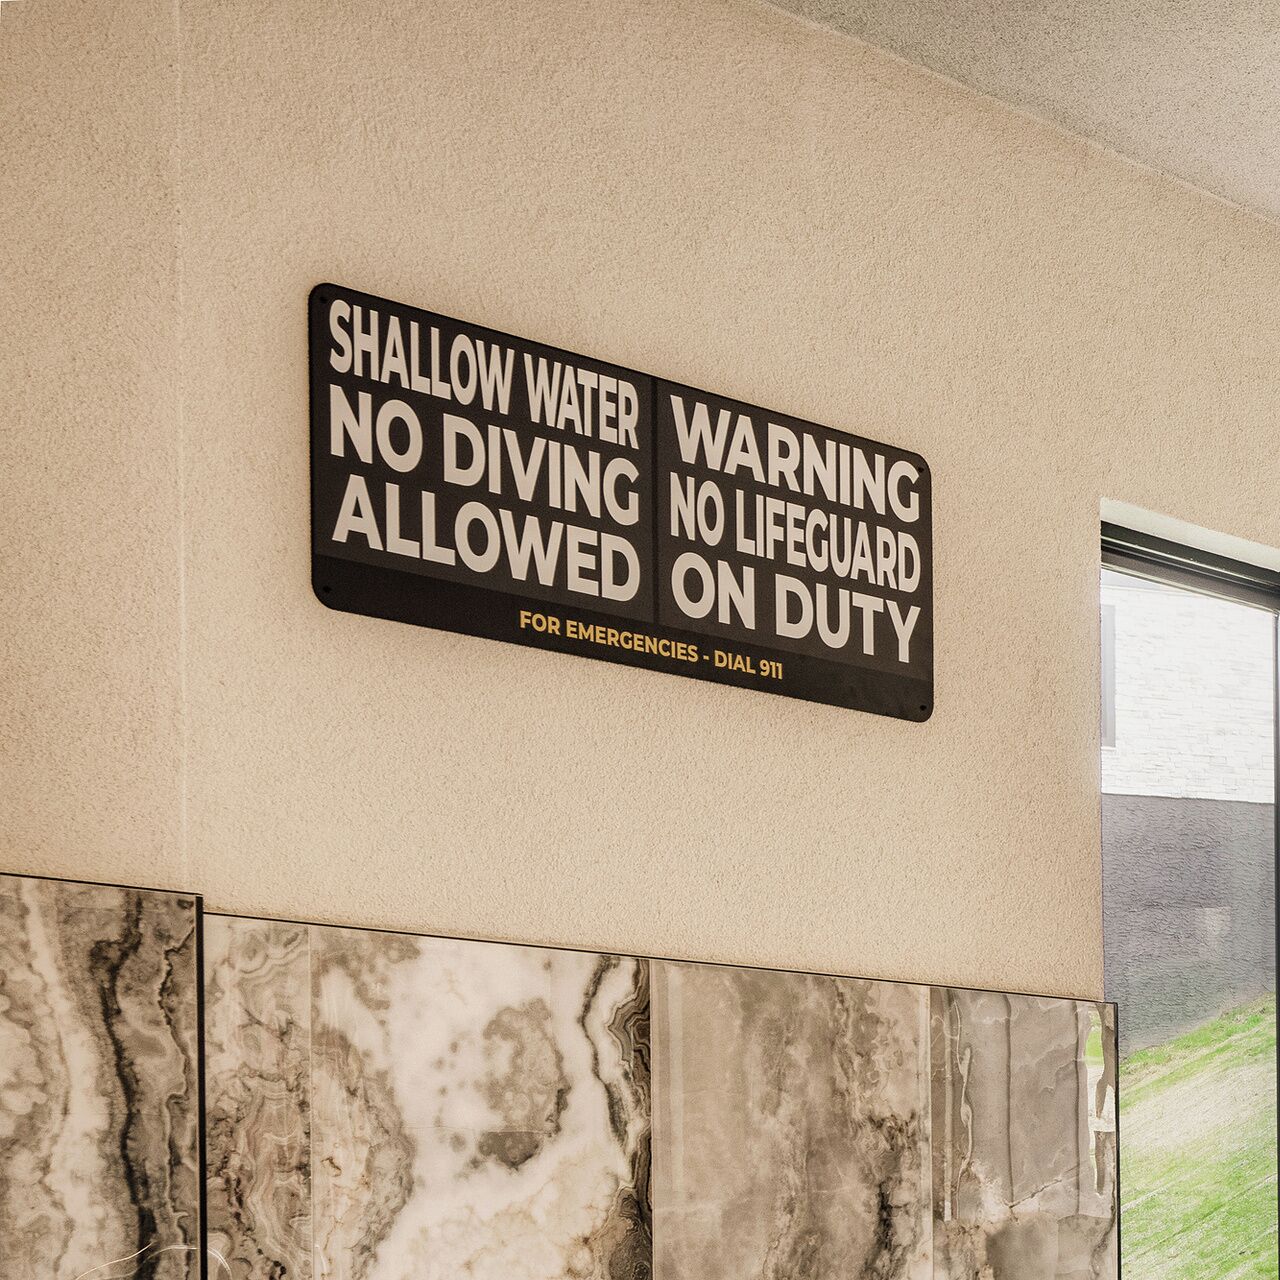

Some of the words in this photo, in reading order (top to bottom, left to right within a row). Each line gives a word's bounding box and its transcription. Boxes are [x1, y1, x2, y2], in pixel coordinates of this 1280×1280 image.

[329, 299, 515, 416] SHALLOW
[523, 352, 640, 450] WATER
[329, 383, 423, 473] NO
[442, 412, 640, 526] DIVING
[669, 394, 920, 523] WARNING
[331, 473, 641, 602] ALLOWED
[669, 471, 725, 547] NO
[735, 488, 922, 593] LIFEGUARD
[519, 610, 561, 636] FOR
[566, 619, 699, 663] EMERGENCIES
[714, 649, 757, 676] DIAL
[759, 659, 783, 680] 911
[671, 551, 756, 631] ON
[774, 573, 921, 664] DUTY
